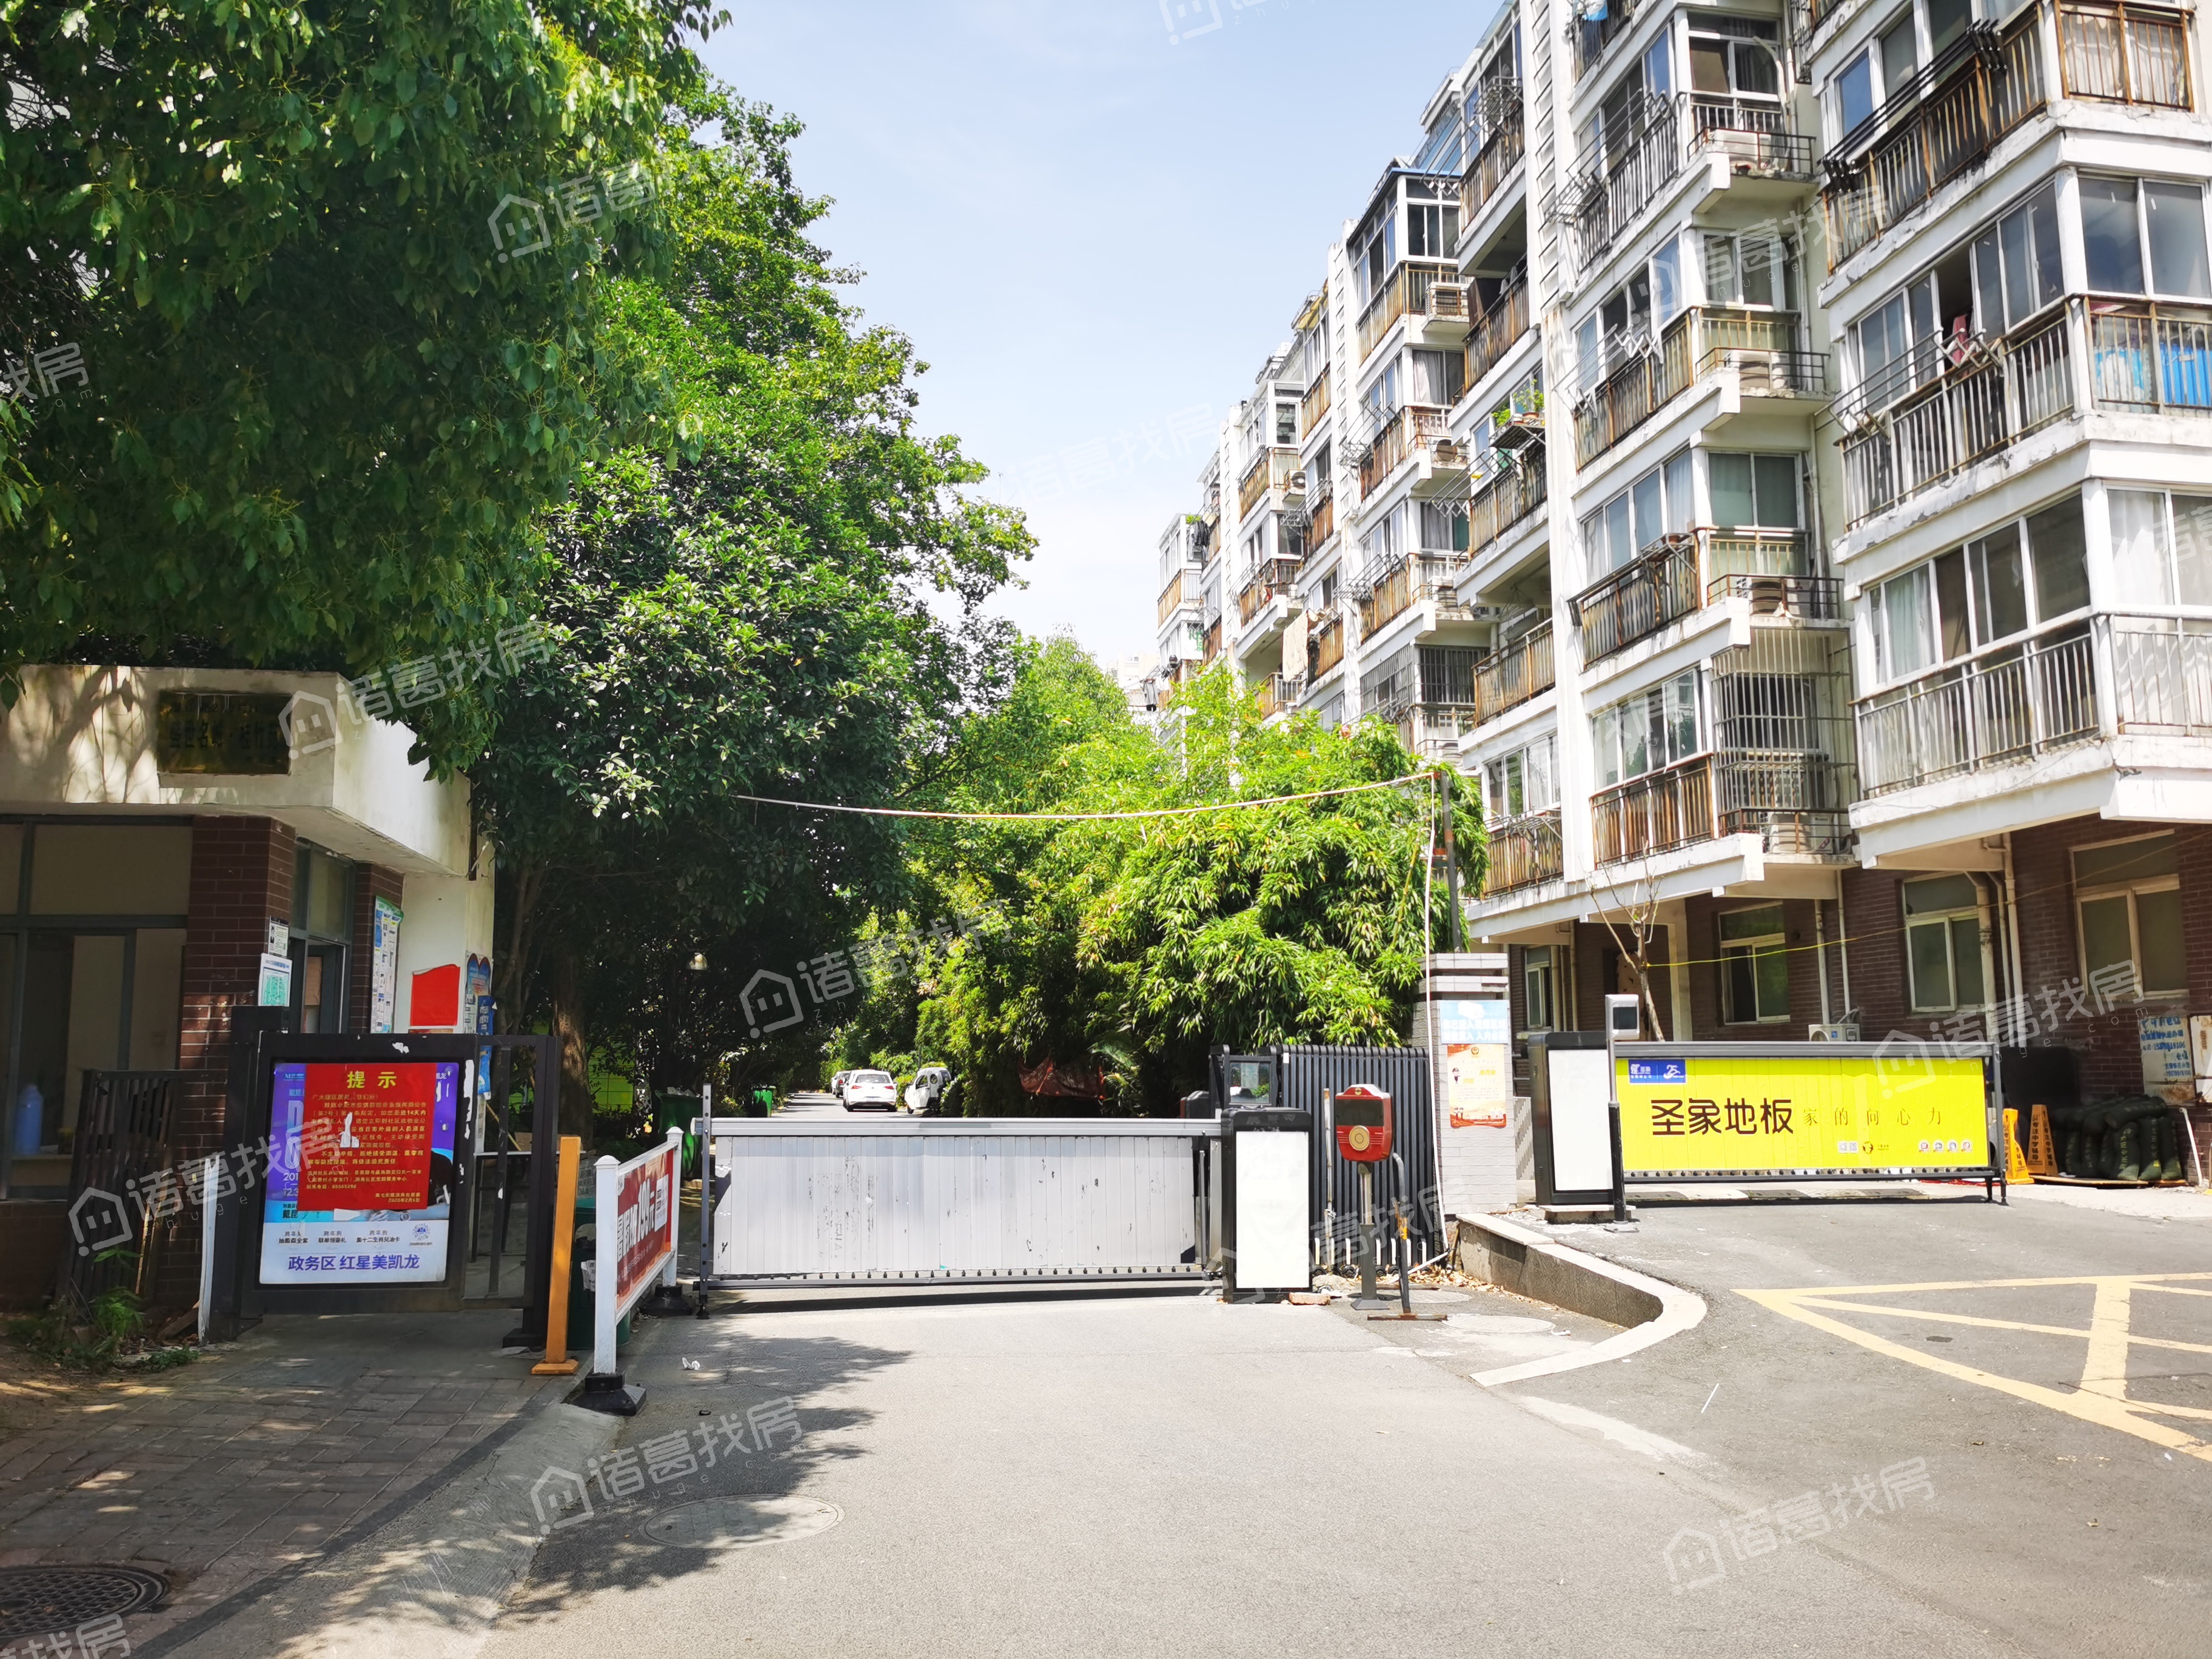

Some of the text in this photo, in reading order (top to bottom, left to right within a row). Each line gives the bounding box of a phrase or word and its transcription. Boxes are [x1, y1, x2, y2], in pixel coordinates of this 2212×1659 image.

[347, 1071, 397, 1088] 提示
[1651, 1098, 1794, 1135] 圣象地板
[1802, 1107, 1941, 1126] 家的向心力
[288, 1253, 420, 1271] 政务区 红星美凯龙
